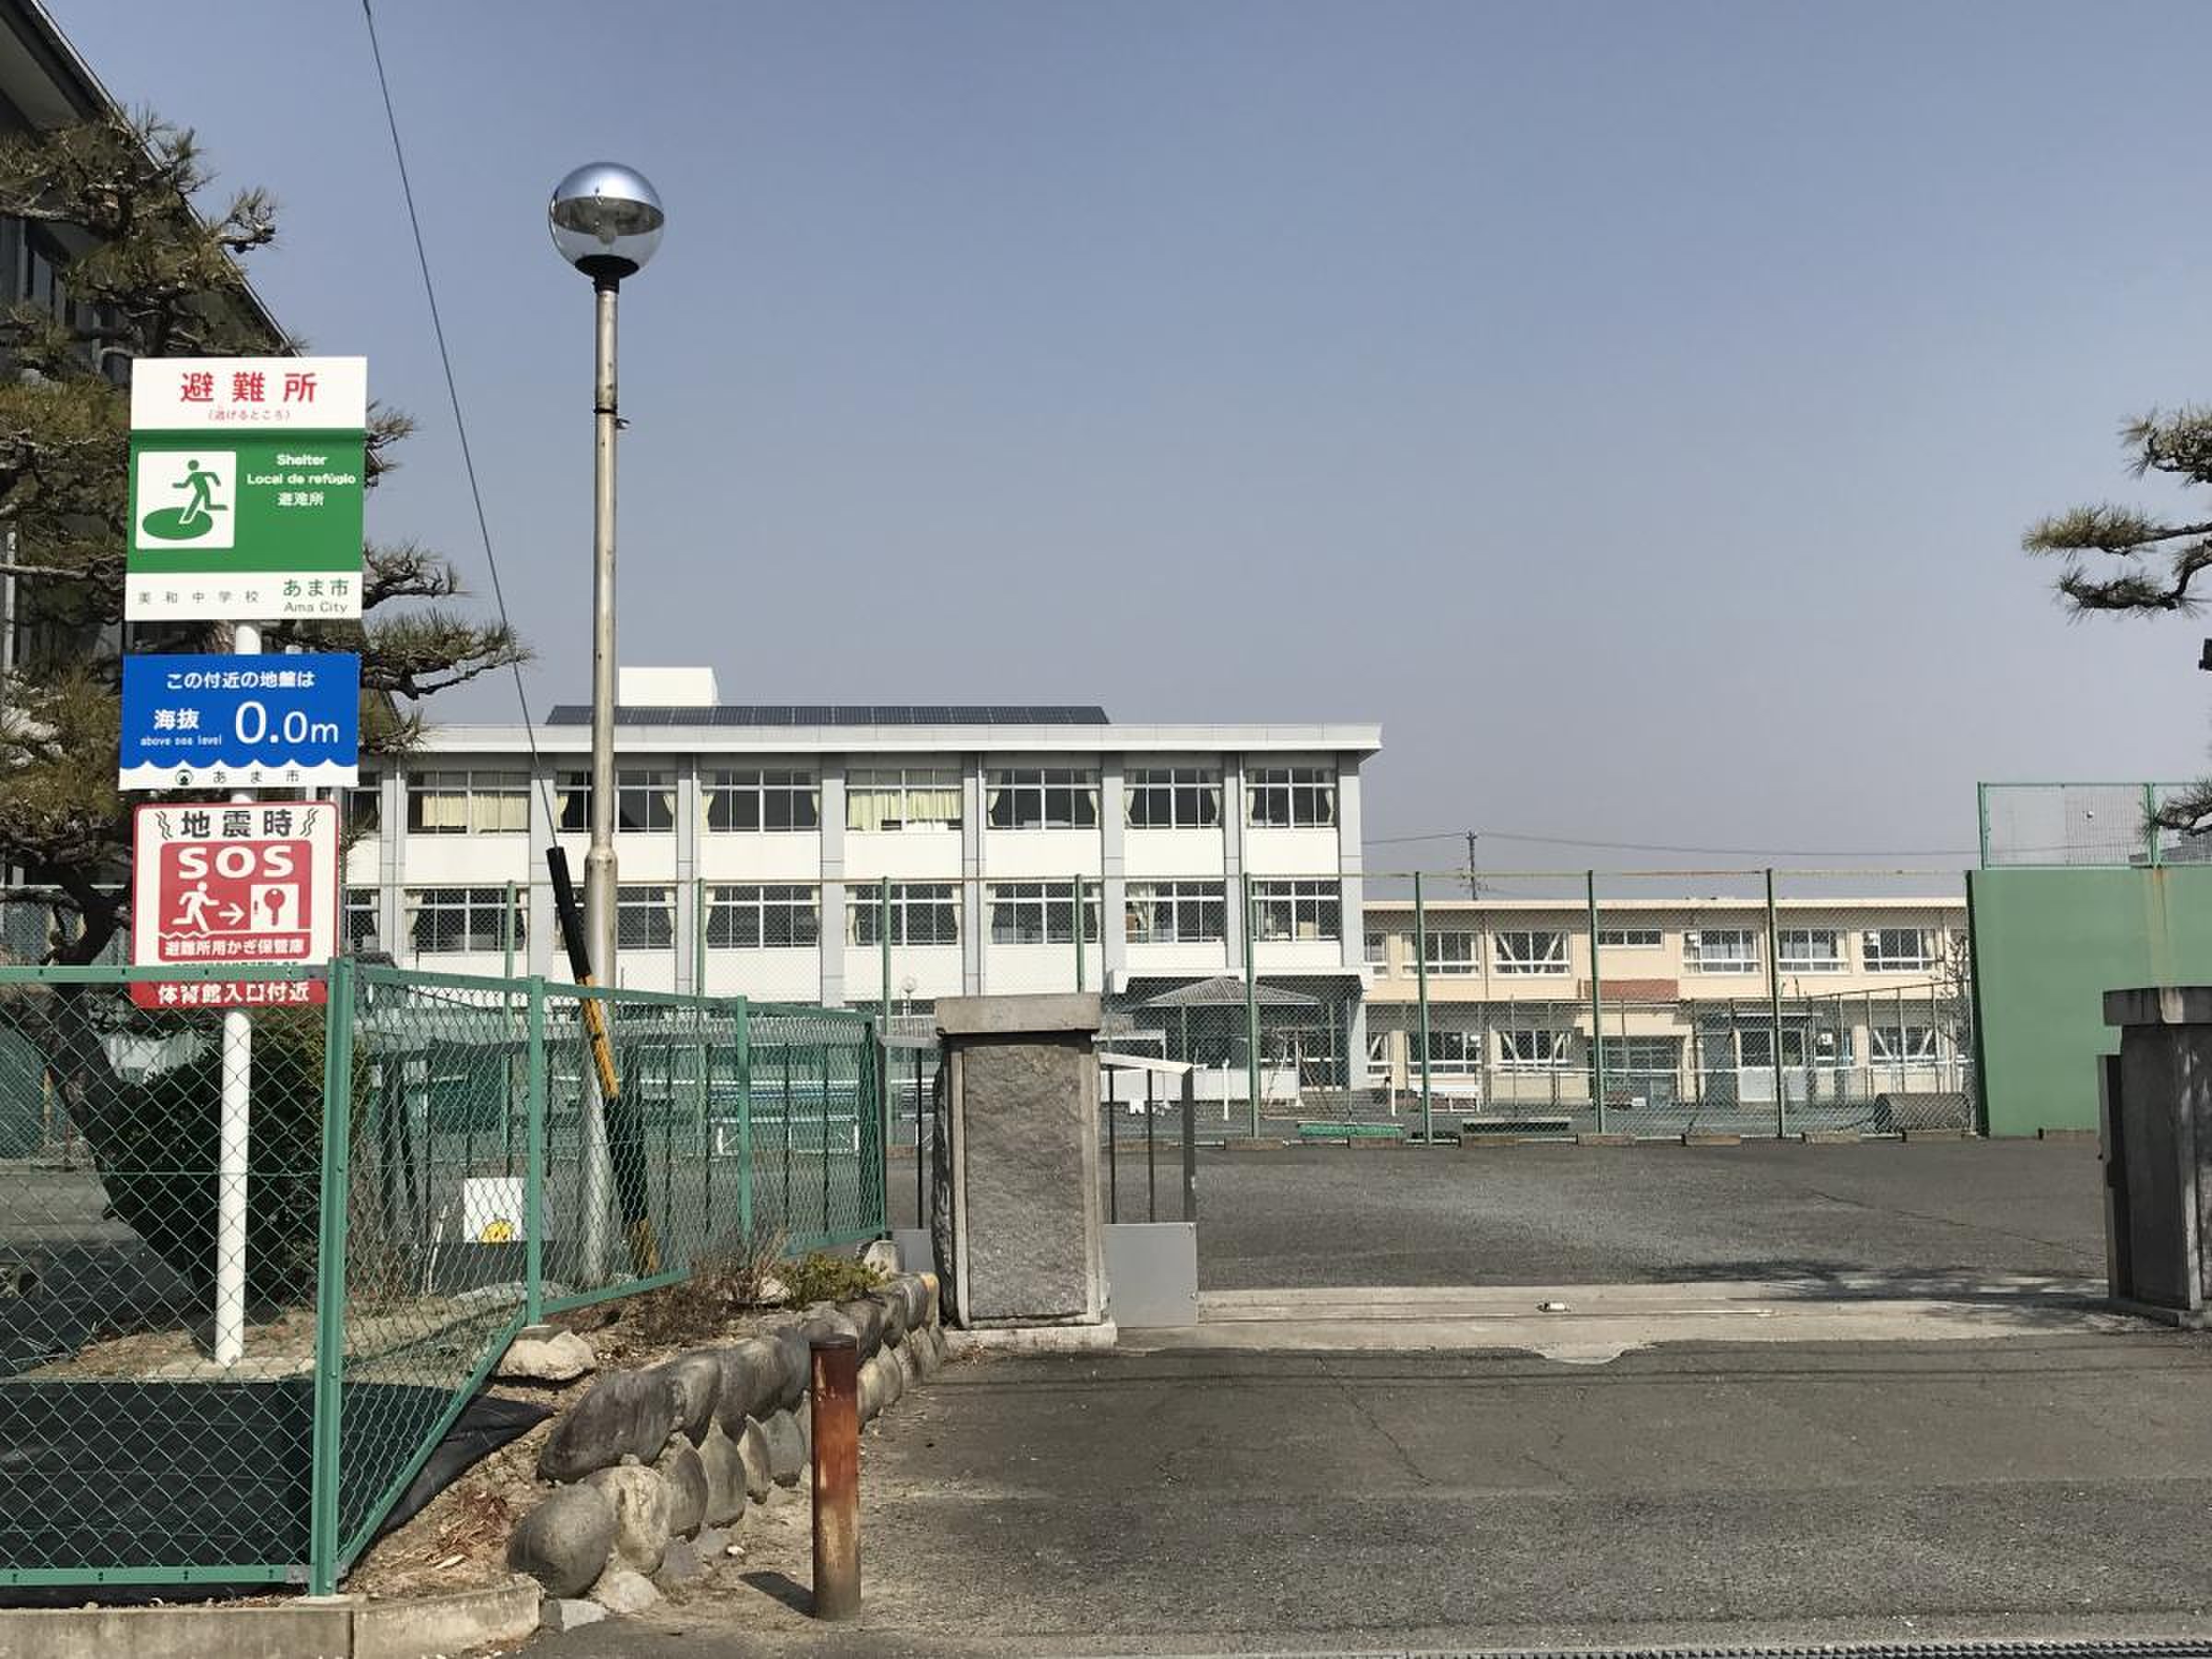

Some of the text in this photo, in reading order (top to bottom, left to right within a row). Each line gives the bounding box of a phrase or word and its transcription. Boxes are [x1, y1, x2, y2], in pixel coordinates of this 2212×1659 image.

[180, 371, 317, 403] 避難所
[276, 453, 328, 466] Shelter
[247, 472, 356, 486] Local de refúgio
[283, 579, 348, 597] あま市
[138, 591, 259, 605] 美和中学校
[284, 601, 347, 615] Ama City
[166, 671, 315, 689] この付近の地盤は
[153, 700, 339, 744] 海抜 0.0m
[140, 735, 222, 747] above sea level
[213, 770, 300, 783] あま市
[181, 809, 293, 840] 地震時
[178, 845, 295, 880] SOS
[158, 982, 310, 1004] 体育館入口付近
